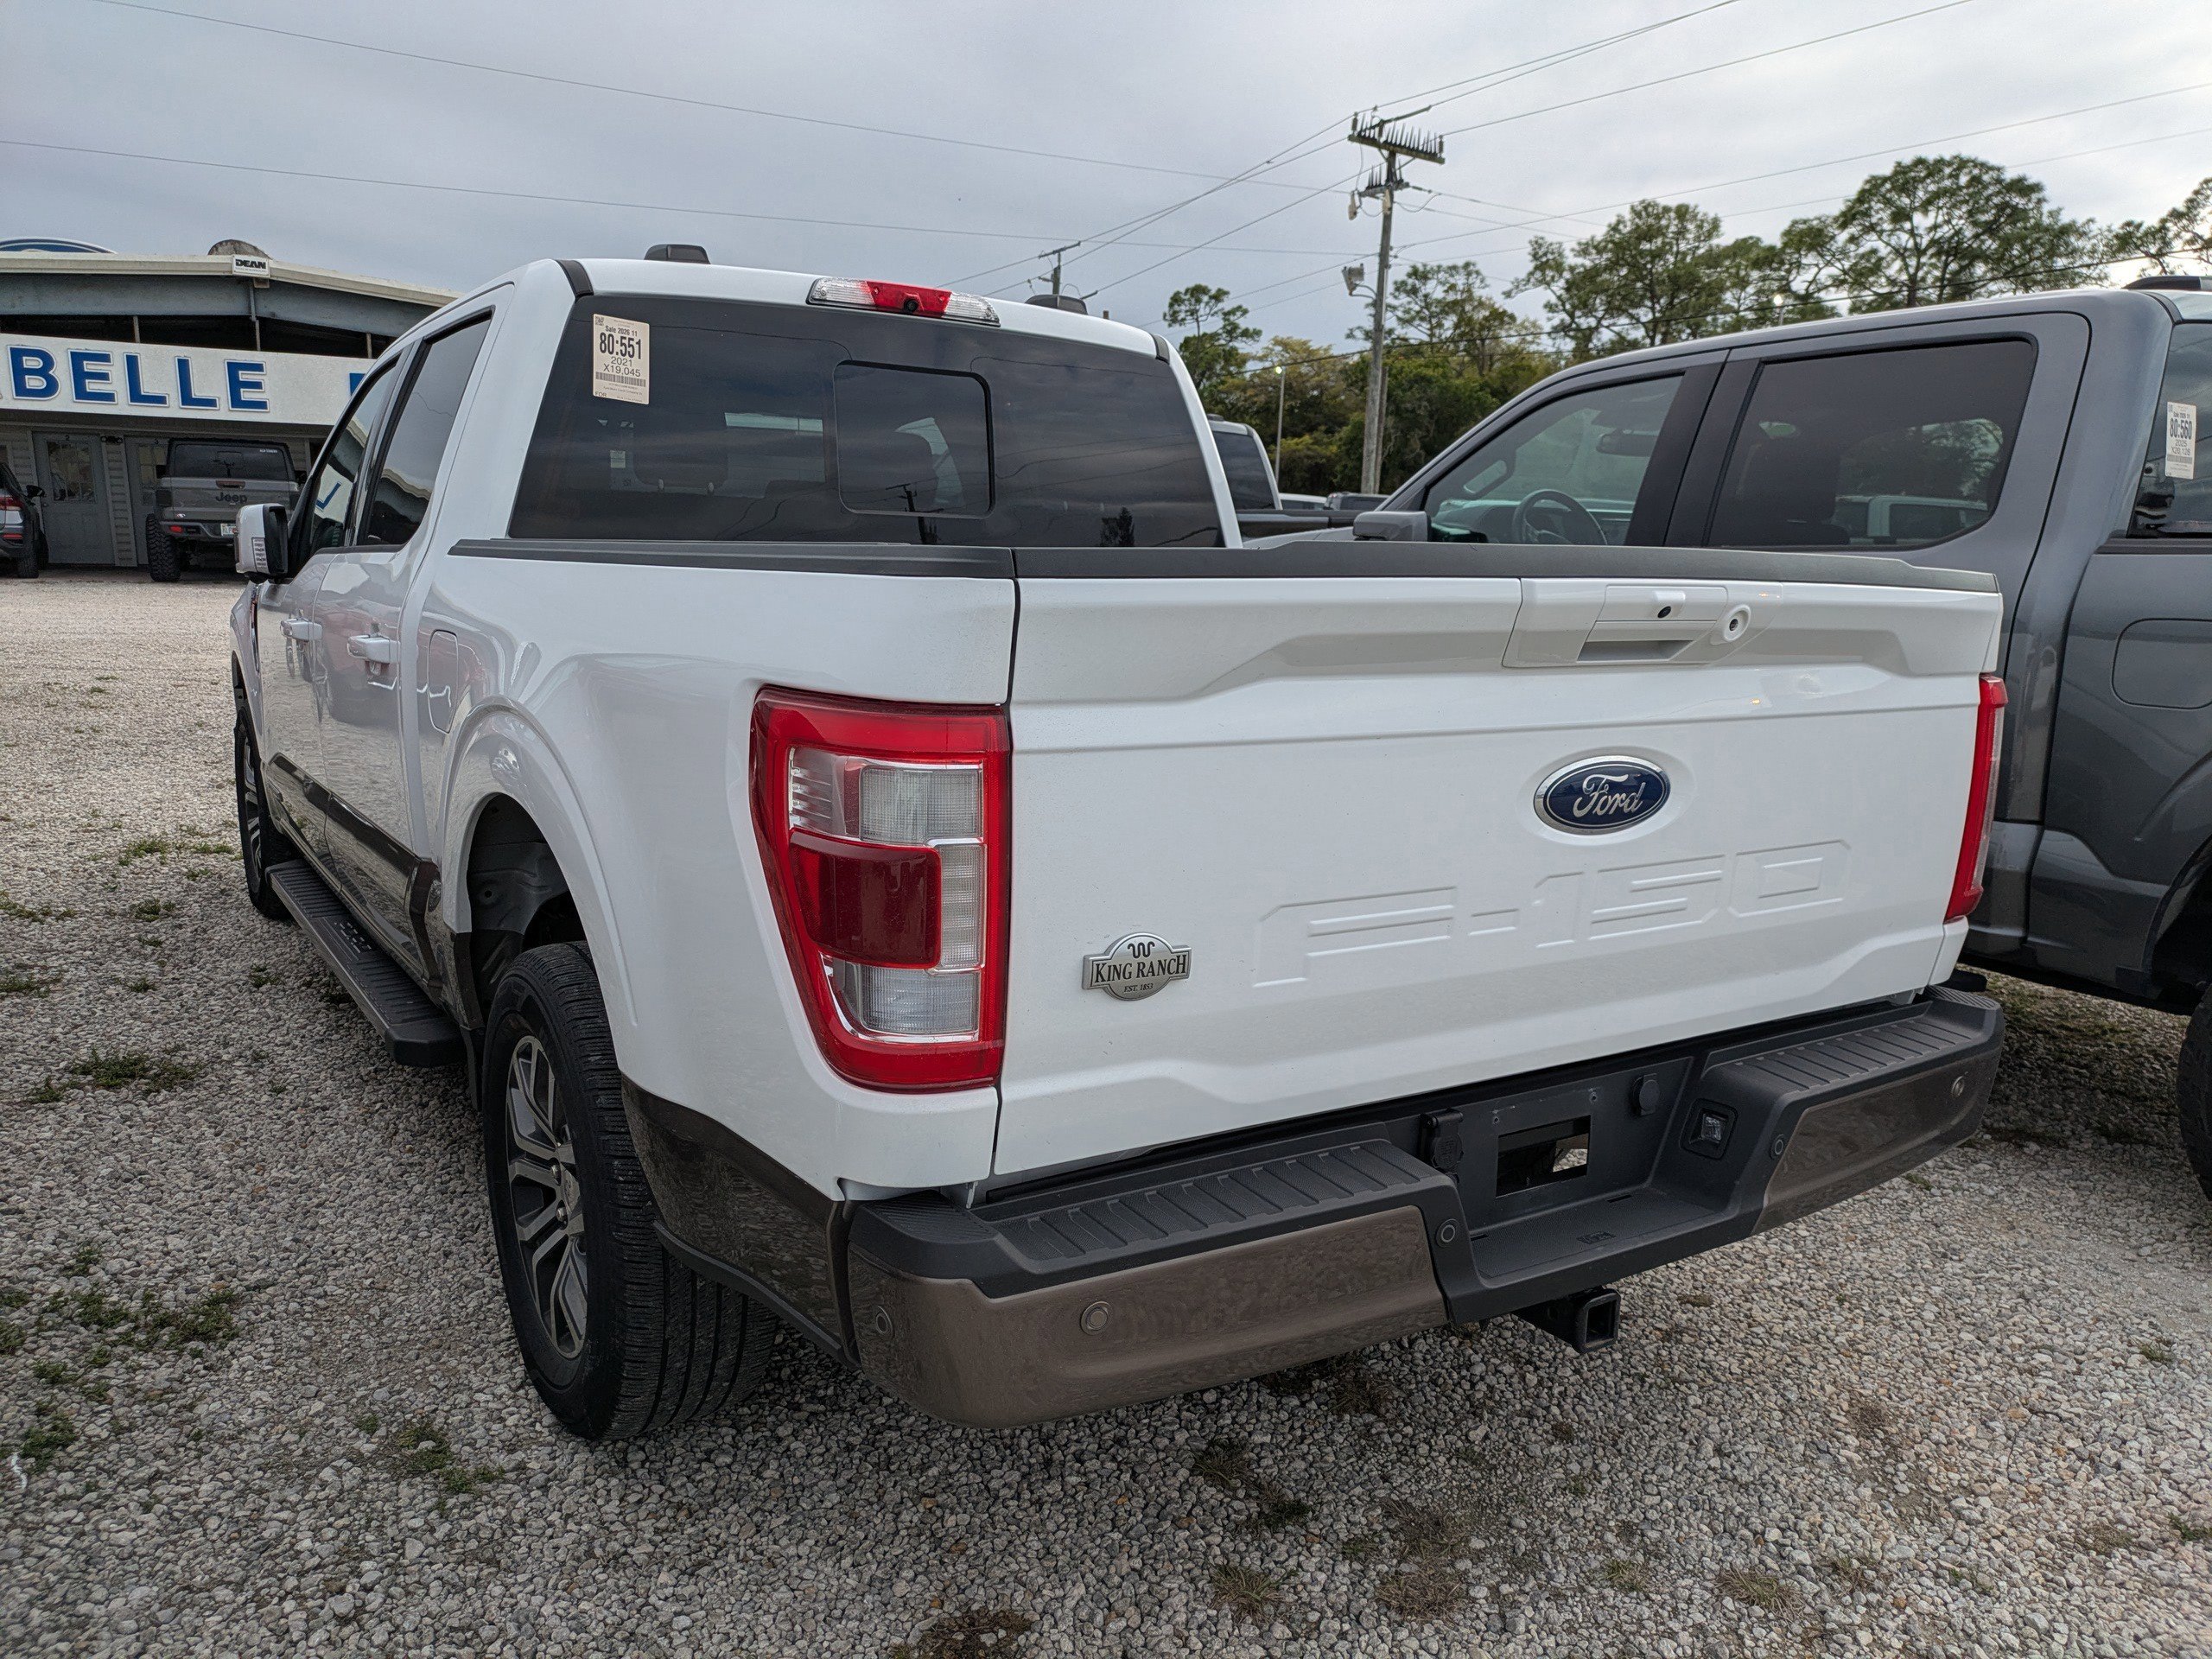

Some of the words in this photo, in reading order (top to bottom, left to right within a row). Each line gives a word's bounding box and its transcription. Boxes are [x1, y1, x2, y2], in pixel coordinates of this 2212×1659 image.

[235, 258, 267, 270] DEAN
[605, 325, 617, 334] Sale
[618, 327, 630, 336] 2026
[599, 332, 642, 359] 80:551
[610, 356, 632, 367] 2021
[2170, 418, 2193, 441] 80:560
[215, 492, 248, 504] Jeep
[1573, 773, 1647, 818] Ford
[1253, 838, 1853, 988] F-150
[1094, 963, 1133, 983] KING
[1136, 954, 1187, 979] RANCH
[1140, 982, 1154, 991] 1853
